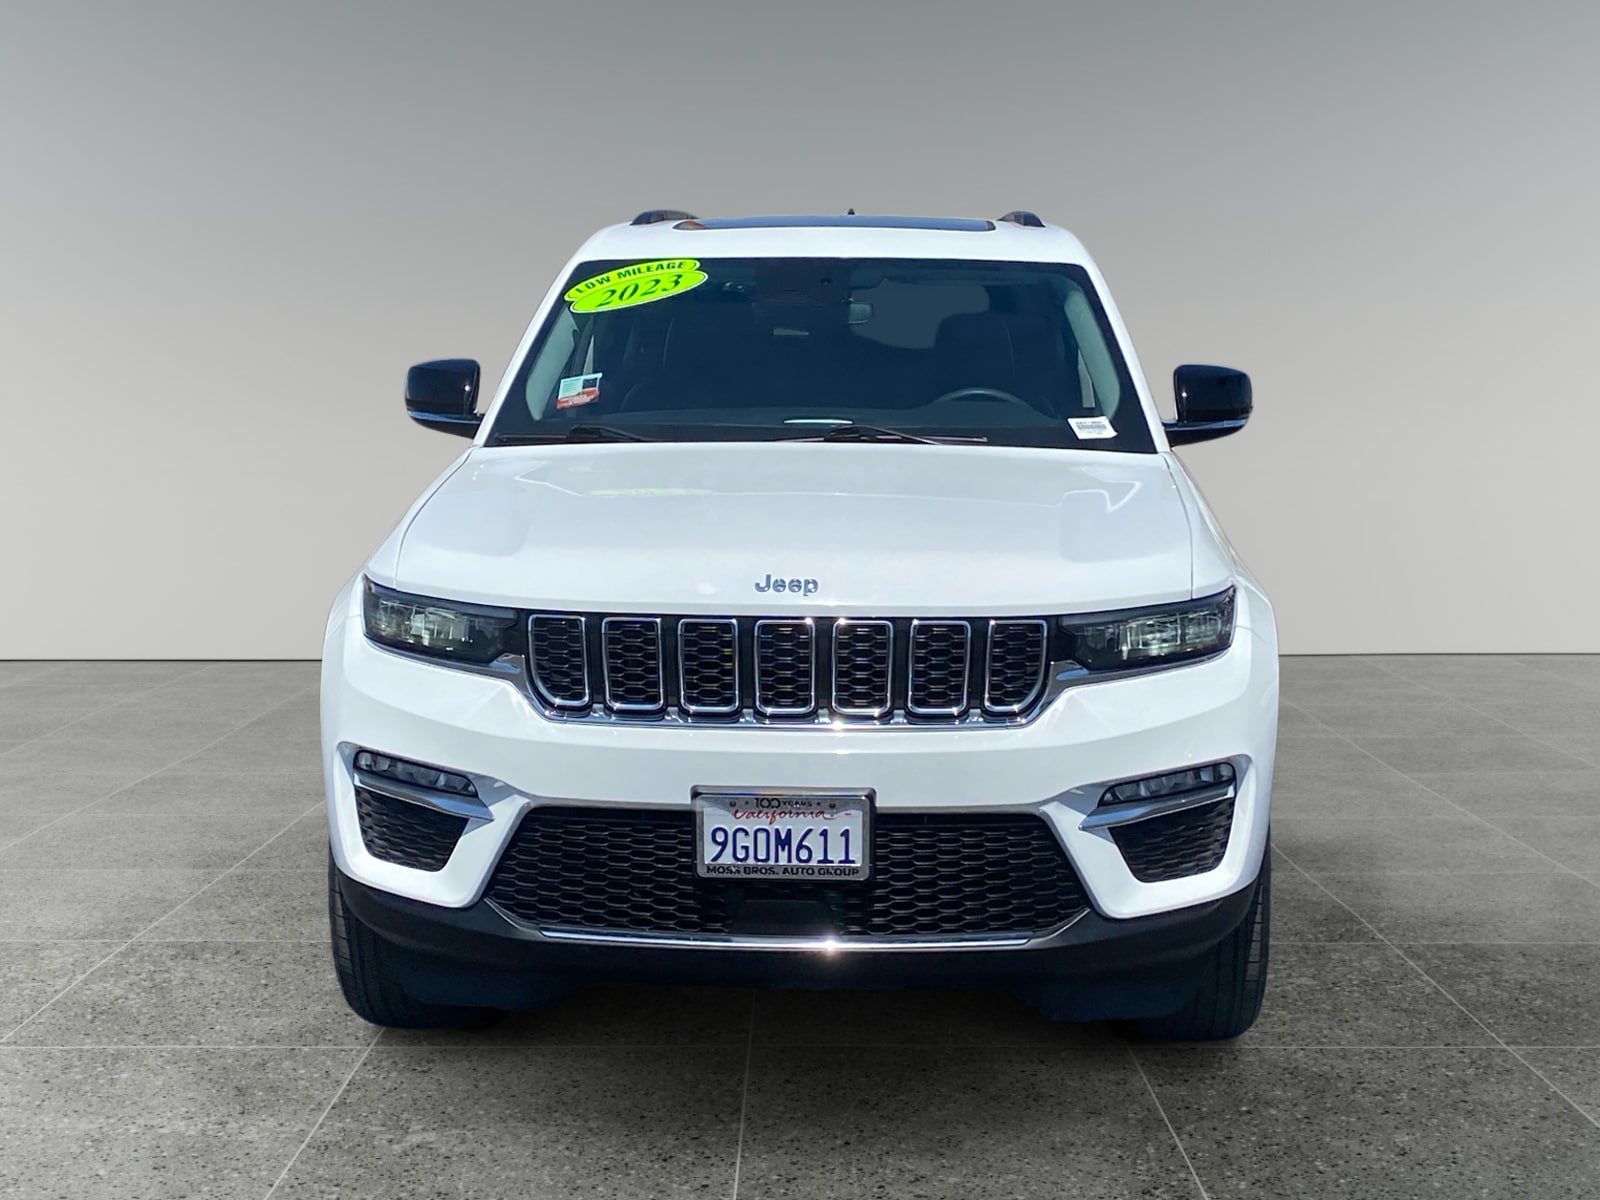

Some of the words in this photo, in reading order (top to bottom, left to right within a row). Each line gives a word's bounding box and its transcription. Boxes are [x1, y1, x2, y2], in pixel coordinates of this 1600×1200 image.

[575, 275, 611, 294] LOW
[617, 261, 685, 280] MILEAGE
[596, 274, 683, 308] 2023
[755, 574, 818, 597] Jeep
[755, 797, 781, 809] 100
[733, 809, 837, 826] California
[710, 826, 856, 865] 9GOM611
[706, 865, 741, 875] MOSS
[743, 866, 779, 875] BROS.
[782, 867, 815, 876] AUTO
[817, 867, 860, 876] GROUP
